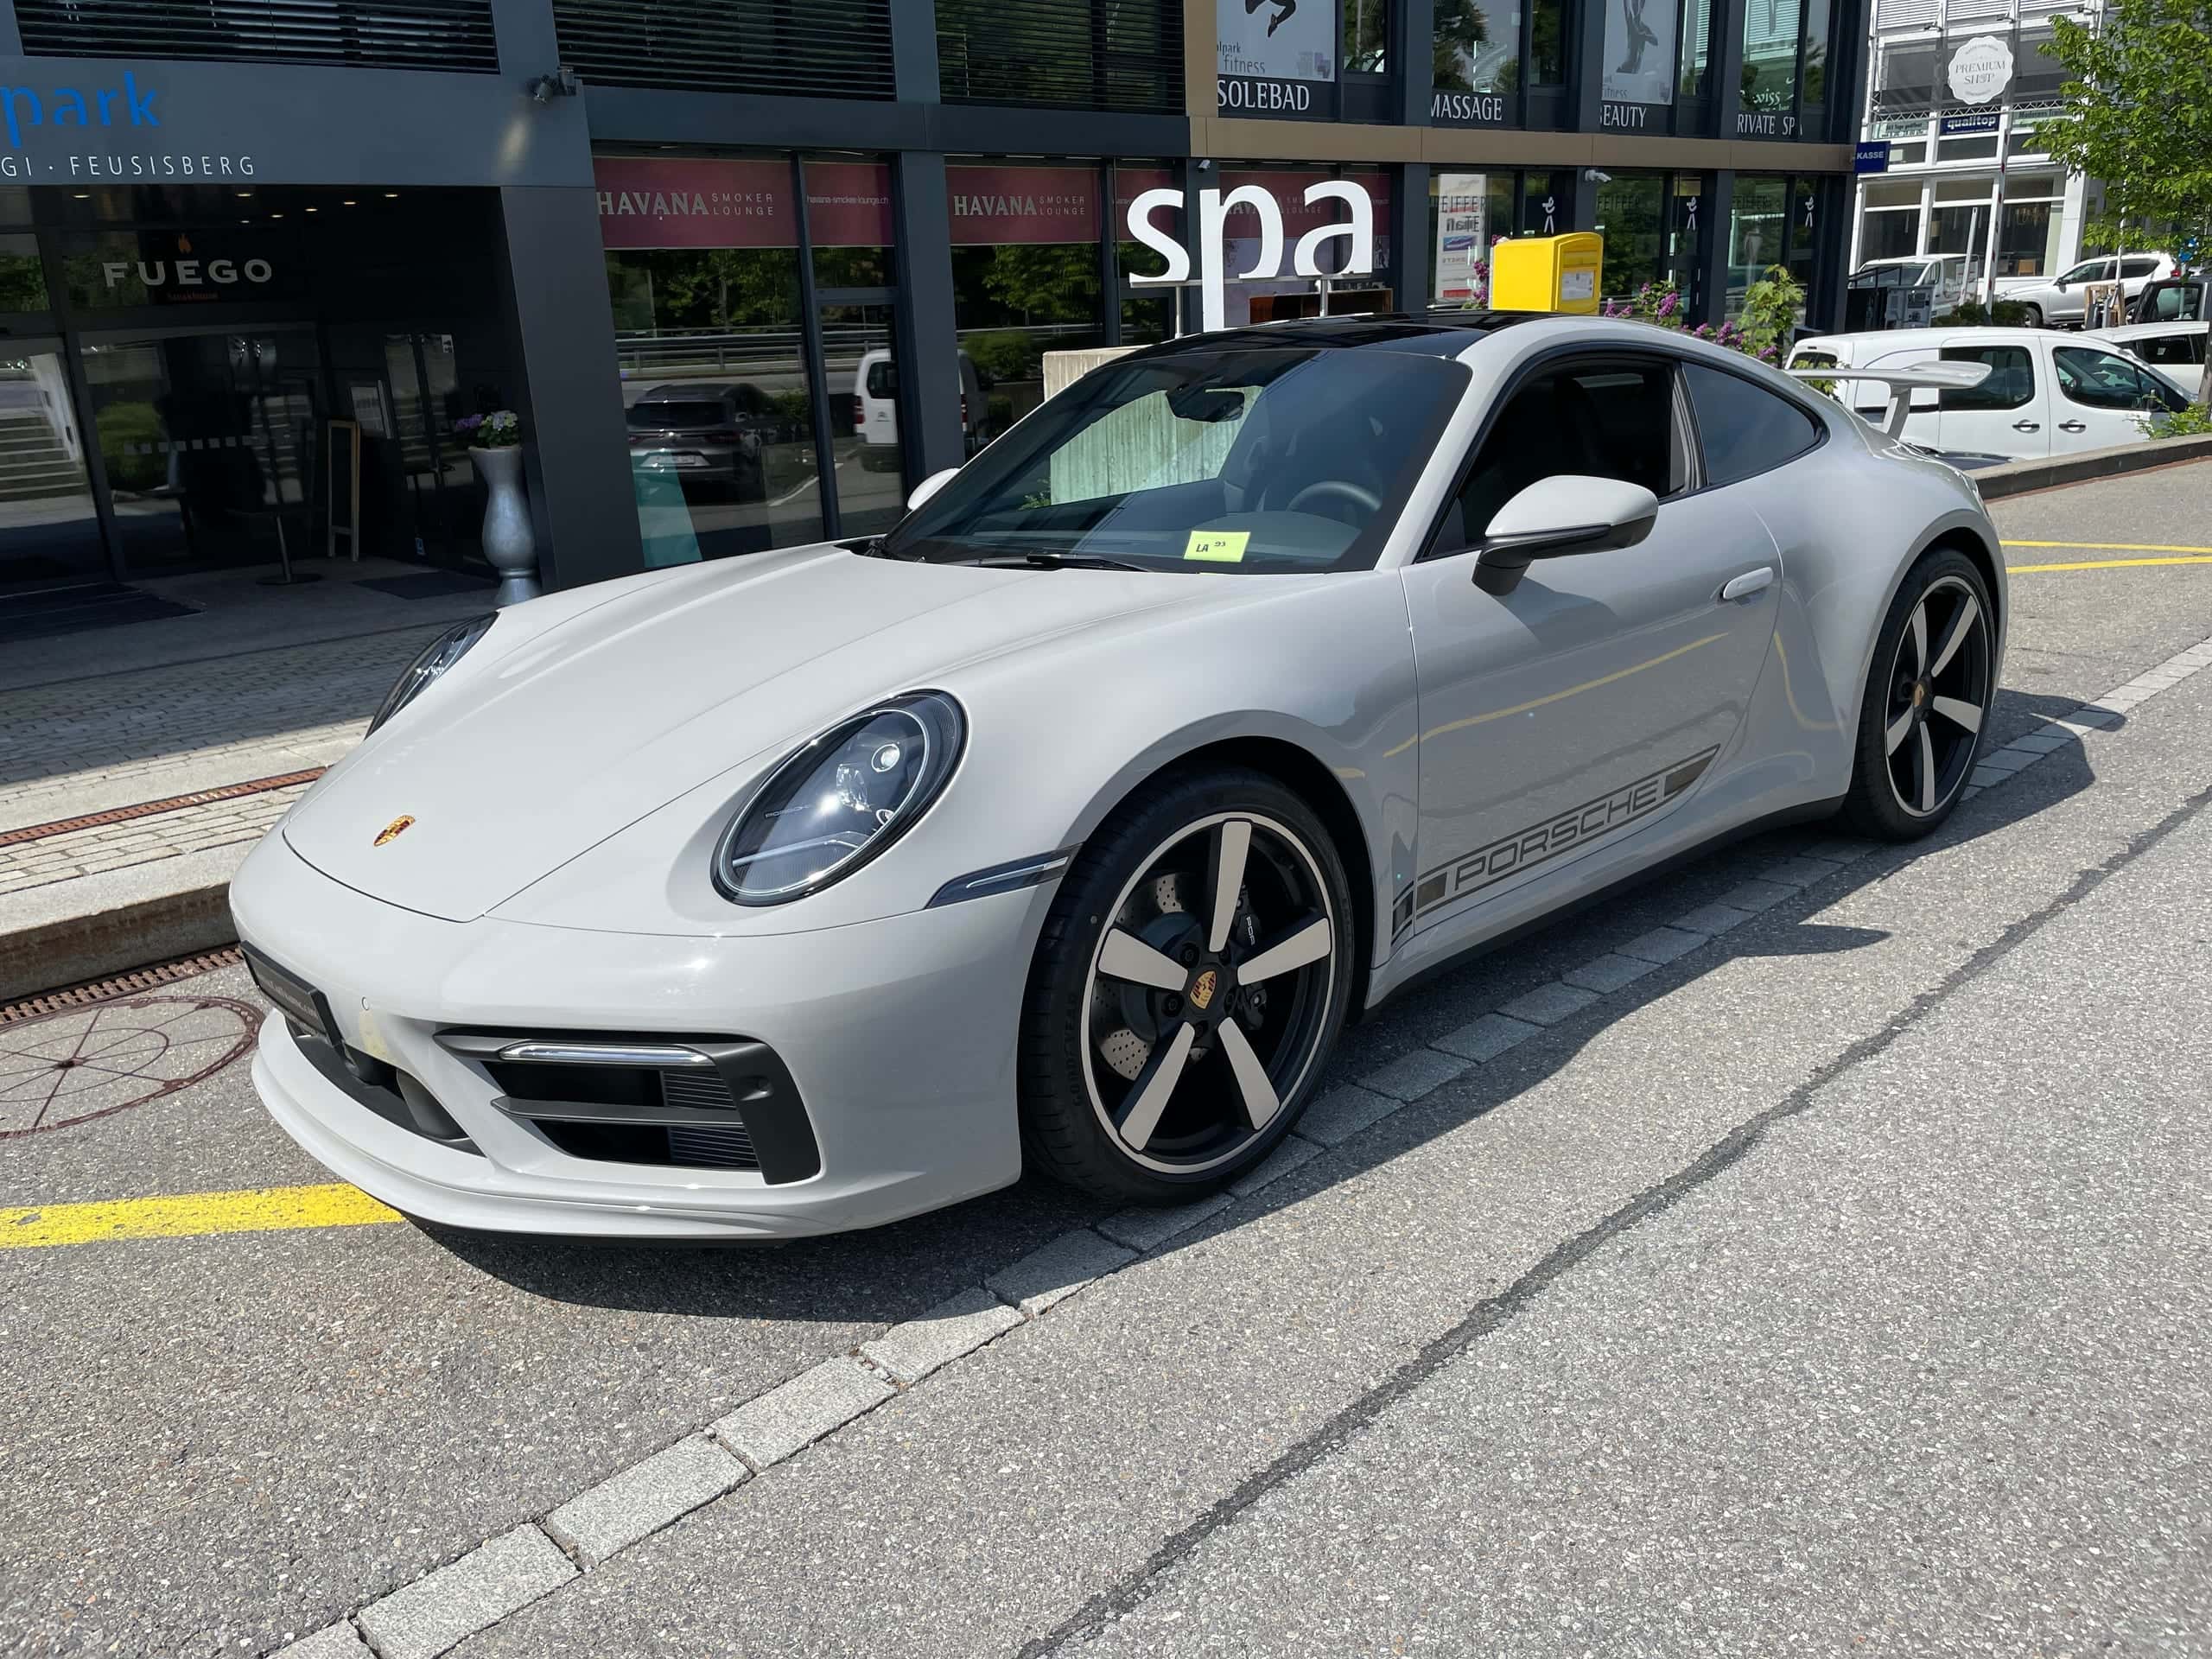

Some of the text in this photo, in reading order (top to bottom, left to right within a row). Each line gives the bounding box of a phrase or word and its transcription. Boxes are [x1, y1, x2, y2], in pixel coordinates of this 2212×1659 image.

[1224, 54, 1266, 74] fitness
[1956, 60, 2005, 73] PREMIUM
[1217, 79, 1310, 111] SOLEBAD
[0, 70, 161, 149] park
[1431, 93, 1503, 121] MASSAGE
[1599, 105, 1647, 128] EAUTY
[1947, 116, 1996, 130] qualitop
[69, 156, 254, 175] FEUSISBERG
[1856, 151, 1885, 160] KASSE
[596, 192, 709, 215] HAVANA
[711, 193, 773, 202] SMOKER
[953, 195, 1037, 216] HAVANA
[1039, 195, 1084, 204] SMOKER
[713, 207, 773, 215] LOUNGE
[1126, 180, 1373, 332] spa
[102, 259, 272, 288] FUEGO
[1455, 779, 1658, 891] PORSCHE
